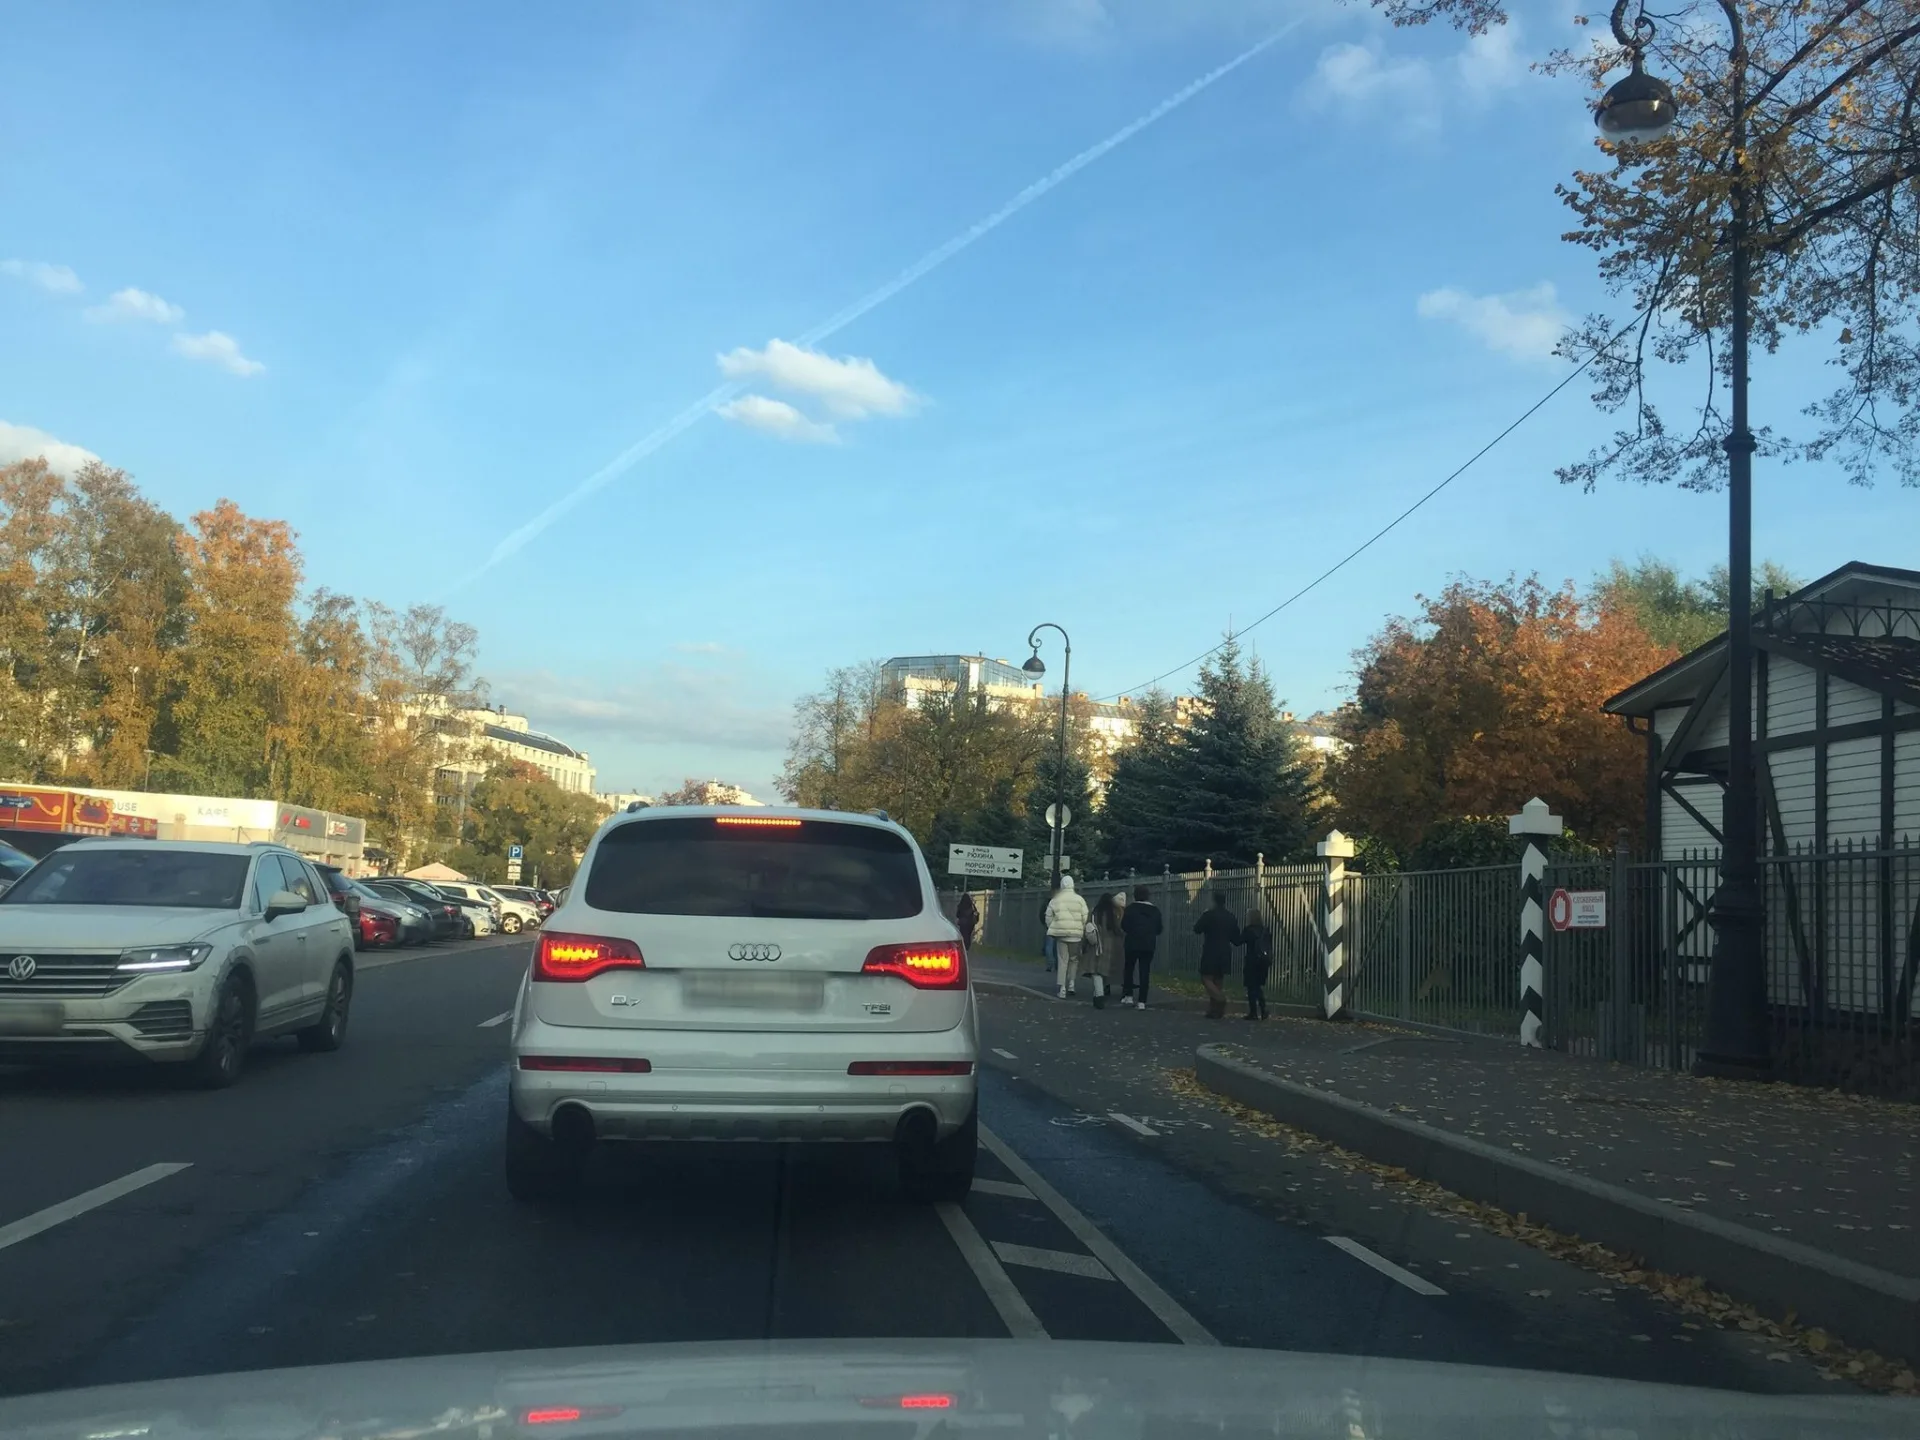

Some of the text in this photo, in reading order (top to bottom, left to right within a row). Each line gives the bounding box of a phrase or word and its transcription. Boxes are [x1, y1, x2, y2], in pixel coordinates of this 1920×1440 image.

[197, 806, 229, 817] КАФЕ
[965, 861, 995, 870] МОРСКОЙ
[611, 994, 641, 1007] Q7
[861, 1003, 891, 1011] TFSI
